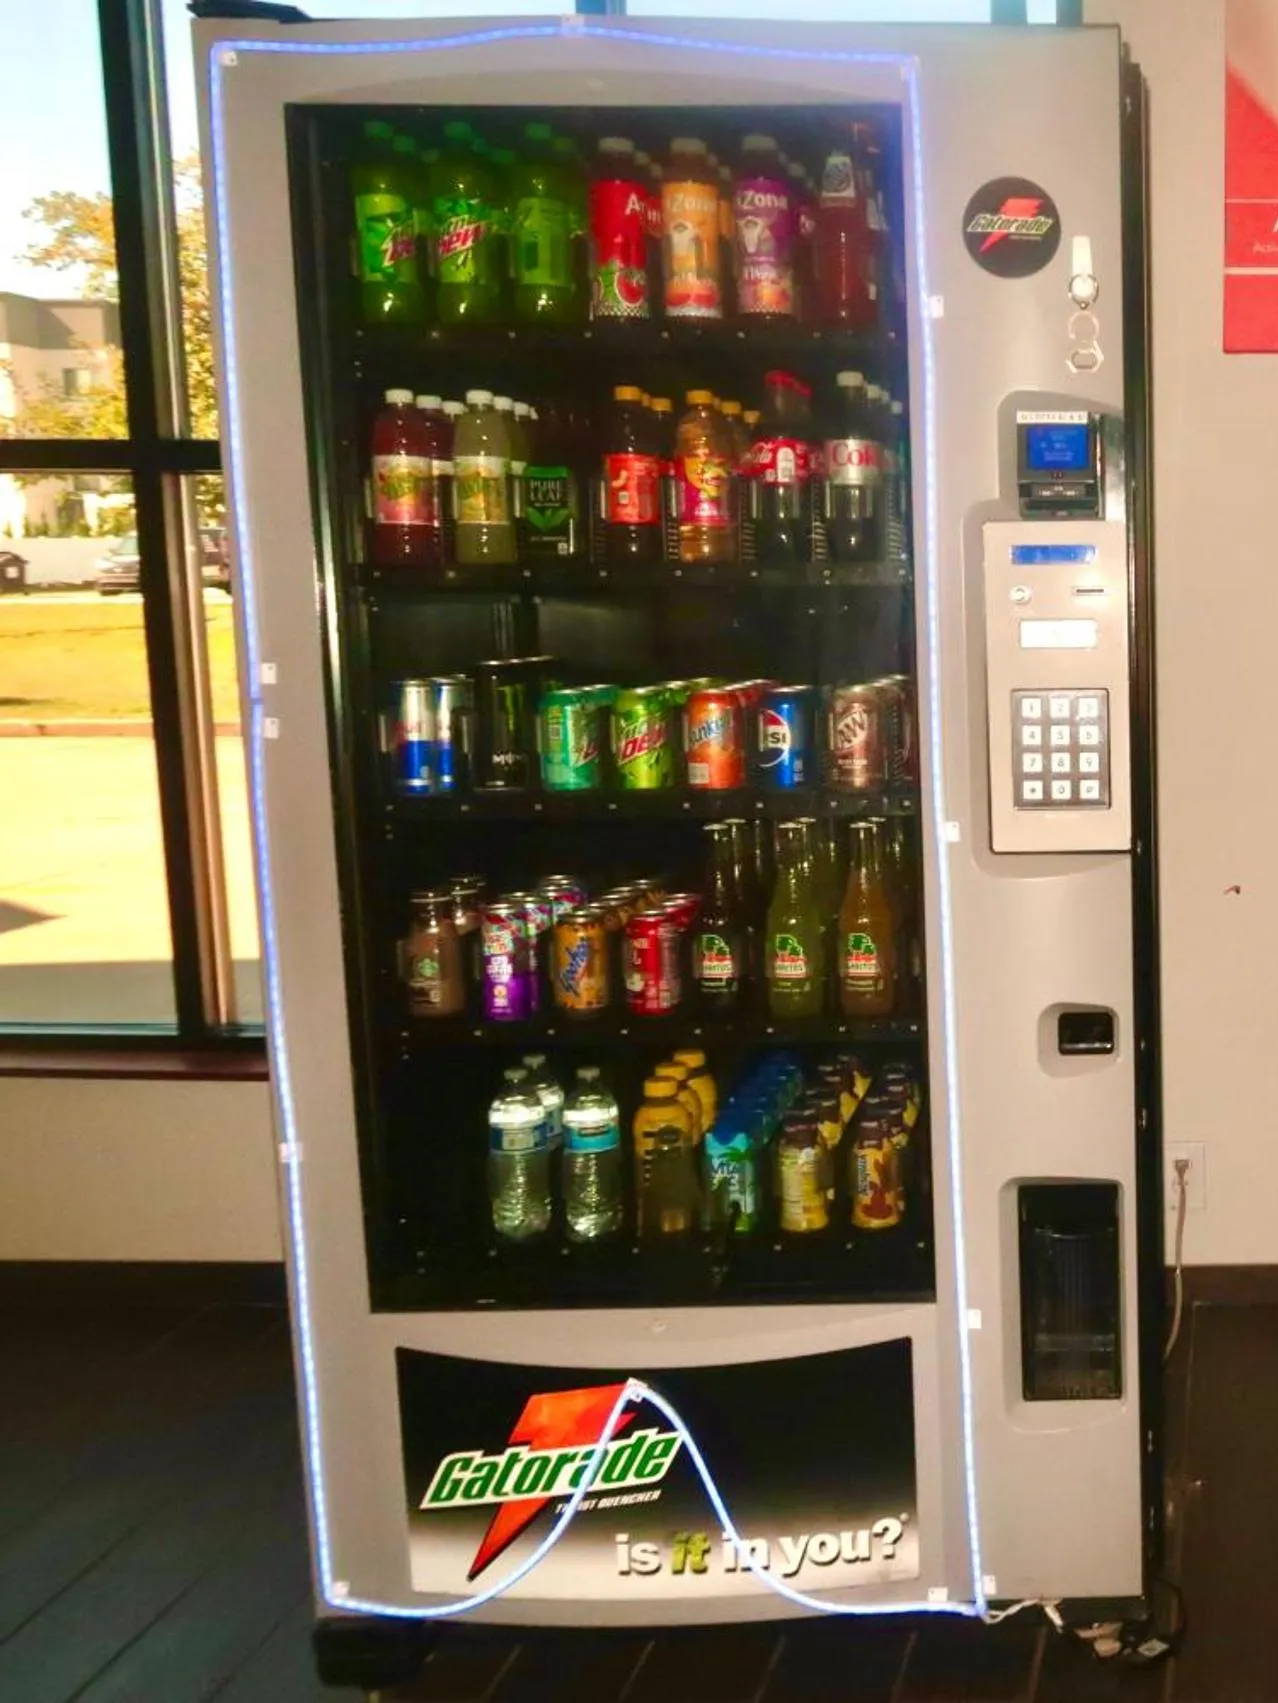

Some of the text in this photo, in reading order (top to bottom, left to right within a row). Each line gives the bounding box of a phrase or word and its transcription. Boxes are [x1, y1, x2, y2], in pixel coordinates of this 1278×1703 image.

[427, 1432, 682, 1506] Gatorade
[615, 1517, 903, 1577] is it in you?
